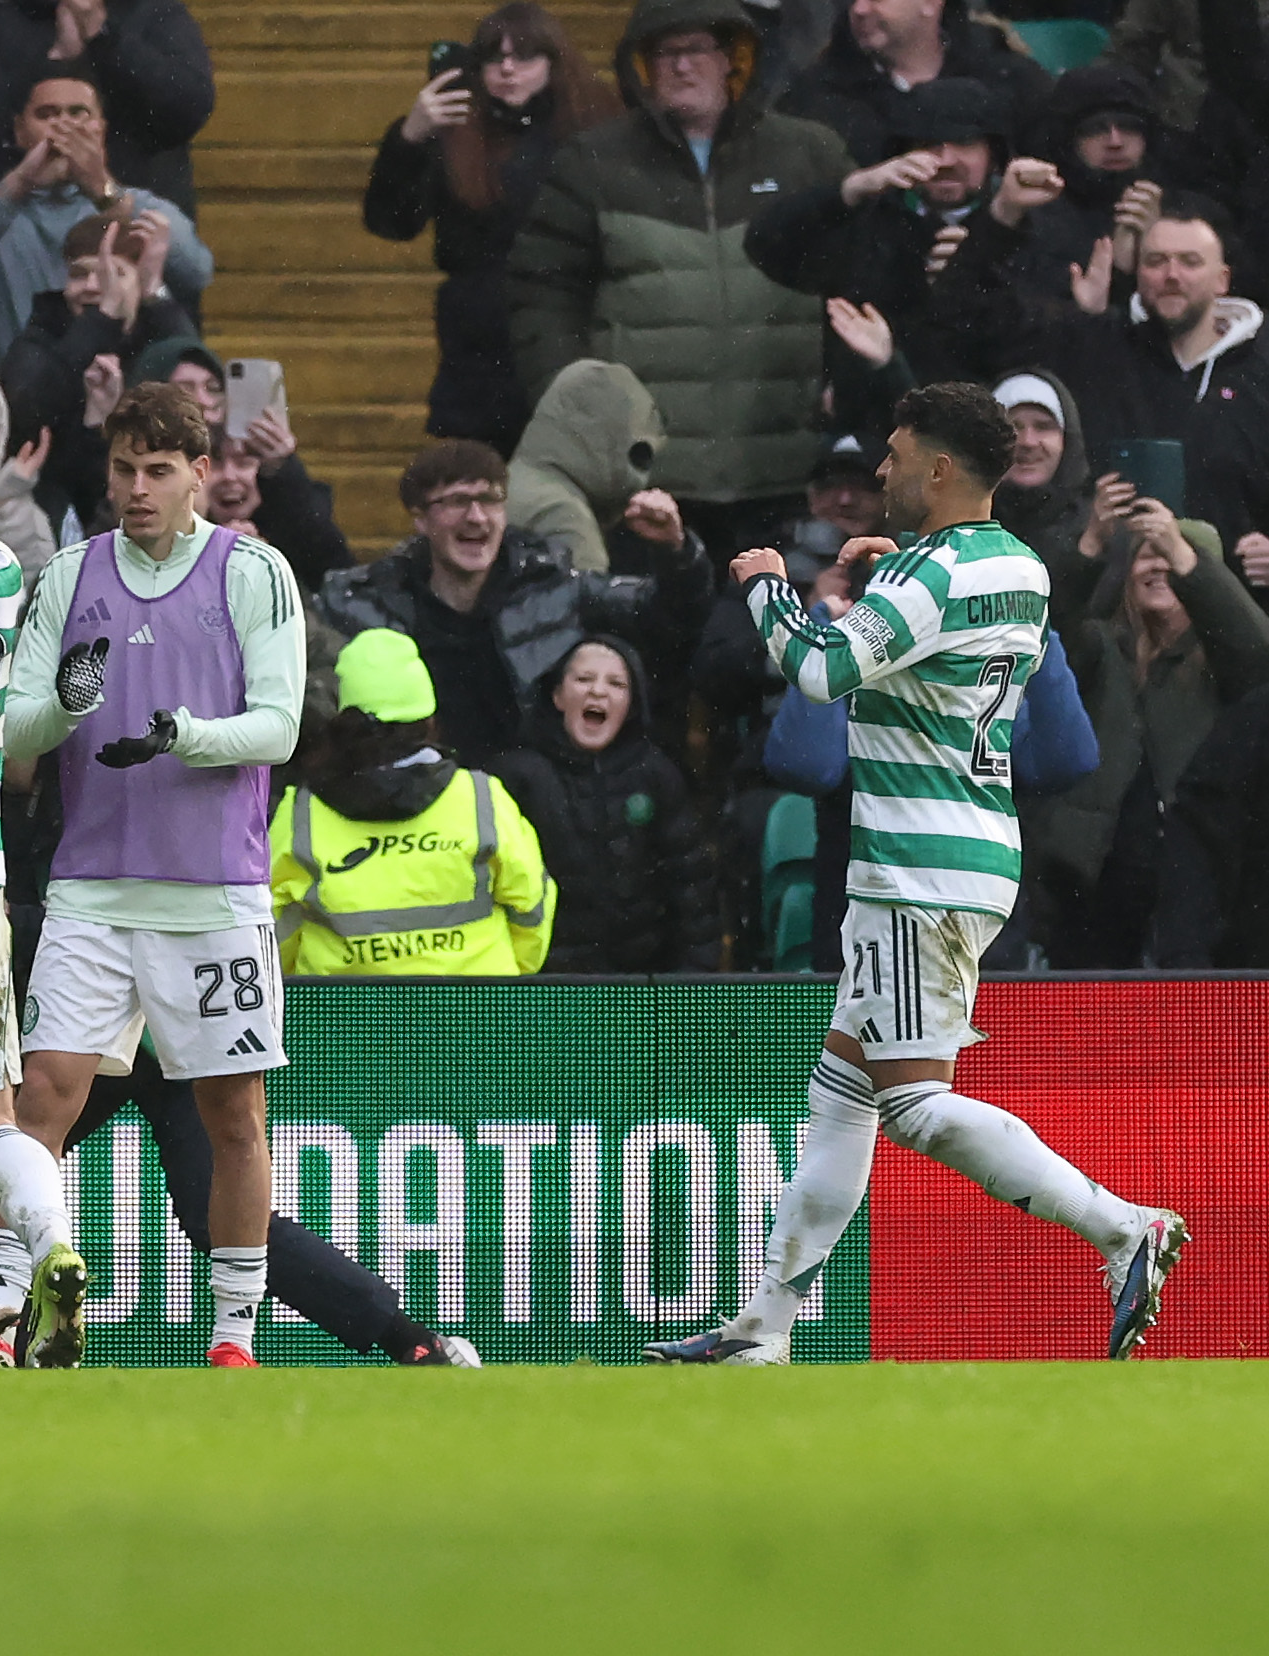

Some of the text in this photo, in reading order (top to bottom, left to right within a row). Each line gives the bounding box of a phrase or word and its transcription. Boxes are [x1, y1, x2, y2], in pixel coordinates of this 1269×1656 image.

[342, 929, 465, 965] STEWARD
[851, 940, 882, 999] 21
[194, 957, 263, 1018] 28
